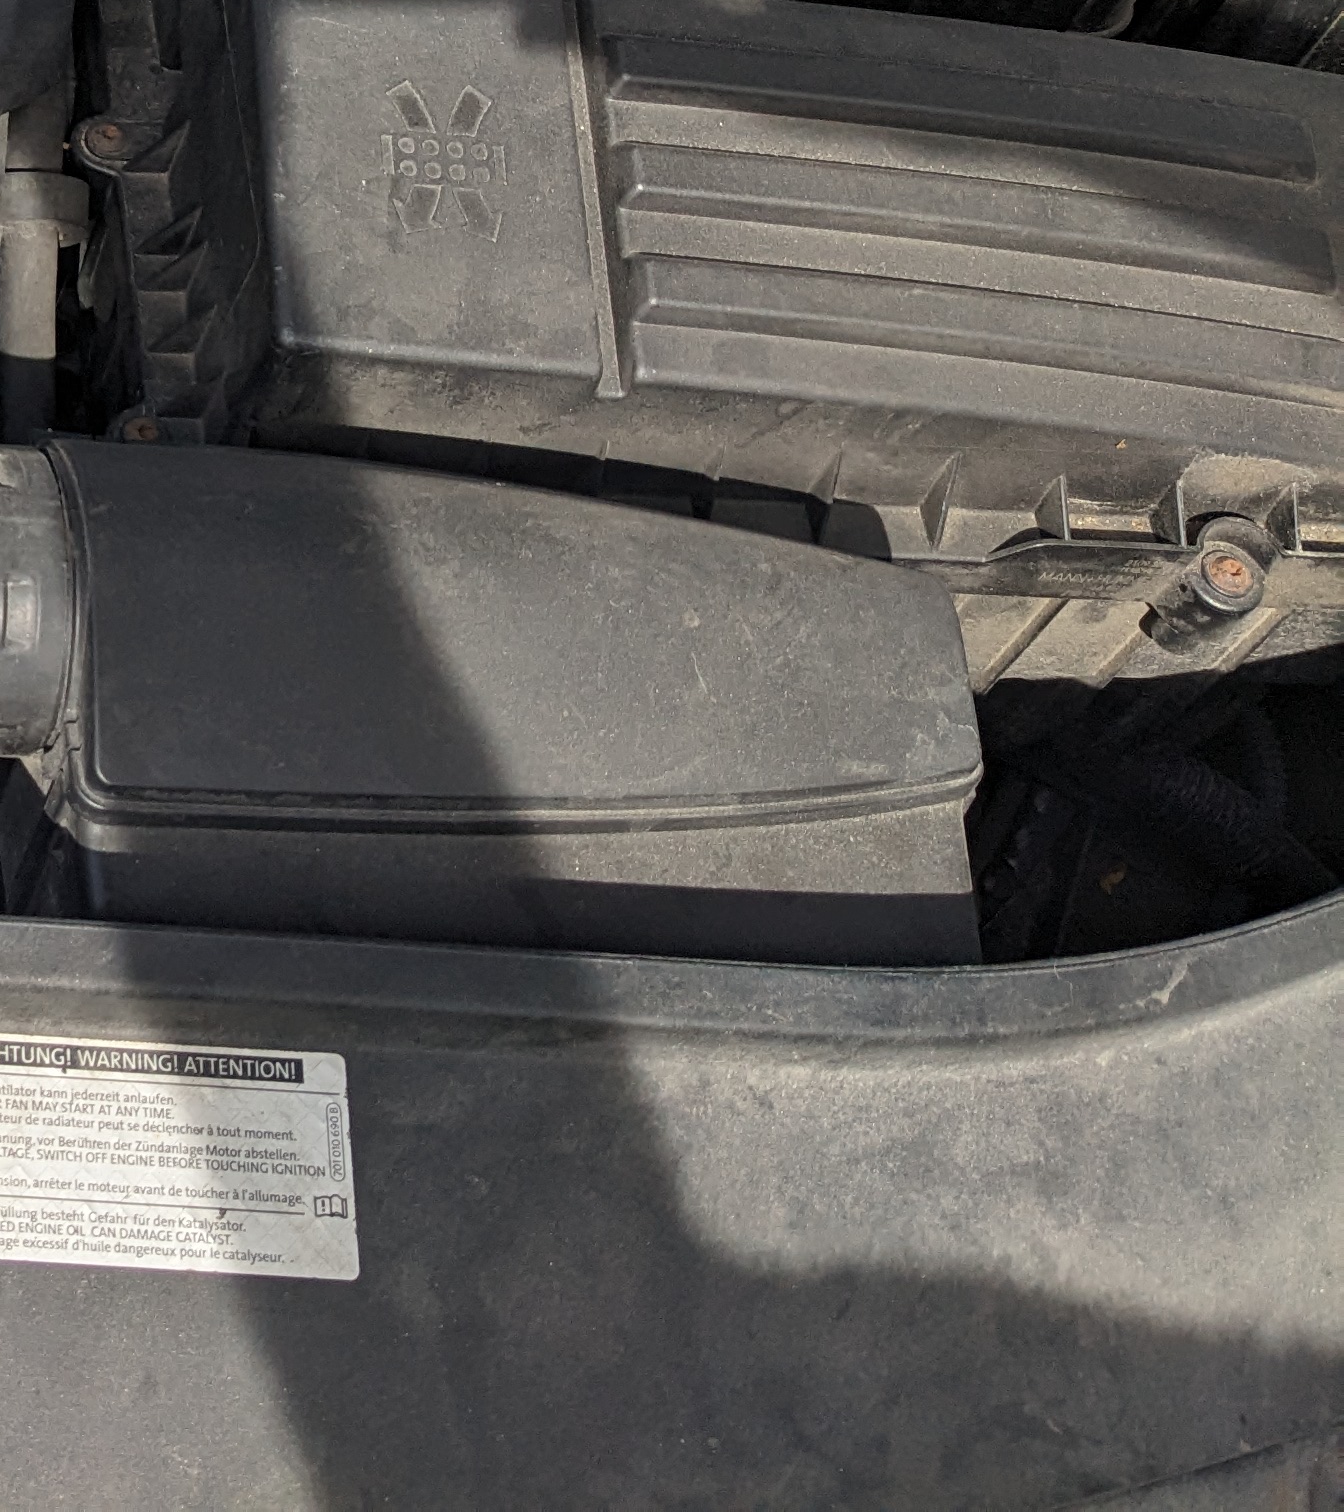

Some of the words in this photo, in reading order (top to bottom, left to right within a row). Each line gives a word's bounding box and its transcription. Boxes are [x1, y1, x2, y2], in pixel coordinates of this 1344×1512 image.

[76, 1048, 178, 1073] WARNING!
[183, 1055, 296, 1080] ATTENTION!
[4, 1098, 28, 1110] FAN
[30, 1100, 59, 1112] MAY
[61, 1101, 95, 1115] START
[97, 1104, 112, 1116] AT
[114, 1105, 139, 1117] ANY
[143, 1106, 175, 1120] TIME.
[39, 1086, 67, 1099] kann
[69, 1087, 120, 1105] jederzeit
[122, 1090, 177, 1106] anlaufen.
[25, 1113, 39, 1125] de
[42, 1114, 94, 1129] radiateur
[97, 1118, 124, 1133] peut
[126, 1121, 139, 1132] se
[215, 1125, 242, 1138] tout
[244, 1127, 297, 1142] moment.
[36, 1136, 55, 1146] vor
[57, 1136, 111, 1151] Berühren
[112, 1139, 133, 1151] der
[135, 1140, 203, 1159] Zündanlage
[205, 1145, 243, 1158] Motor
[244, 1147, 300, 1162] abstellen.
[36, 1148, 83, 1162] SWITCH
[85, 1151, 107, 1164] OFF
[110, 1152, 155, 1167] ENGINE
[158, 1155, 203, 1170] BEFORE
[204, 1158, 269, 1174] TOUCHING
[271, 1162, 326, 1177] IGNITION
[74, 1178, 85, 1191] le
[86, 1180, 130, 1194] moteur
[132, 1184, 165, 1196] avant
[167, 1184, 182, 1197] de
[184, 1186, 230, 1200] toucher
[18, 1221, 63, 1236] ENGINE
[65, 1223, 86, 1237] OIL
[90, 1225, 116, 1238] CAN
[118, 1227, 174, 1242] DAMAGE
[175, 1230, 234, 1246] CATALYST.
[40, 1208, 85, 1222] besteht
[87, 1210, 128, 1225] Gefahr
[132, 1213, 150, 1226] für
[152, 1214, 175, 1228] den
[177, 1216, 247, 1235] Katalysator.
[22, 1235, 68, 1250] excessif
[113, 1241, 176, 1260] dangereux
[178, 1247, 207, 1261] pour
[209, 1246, 221, 1259] le
[222, 1247, 286, 1267] catalyseur.
